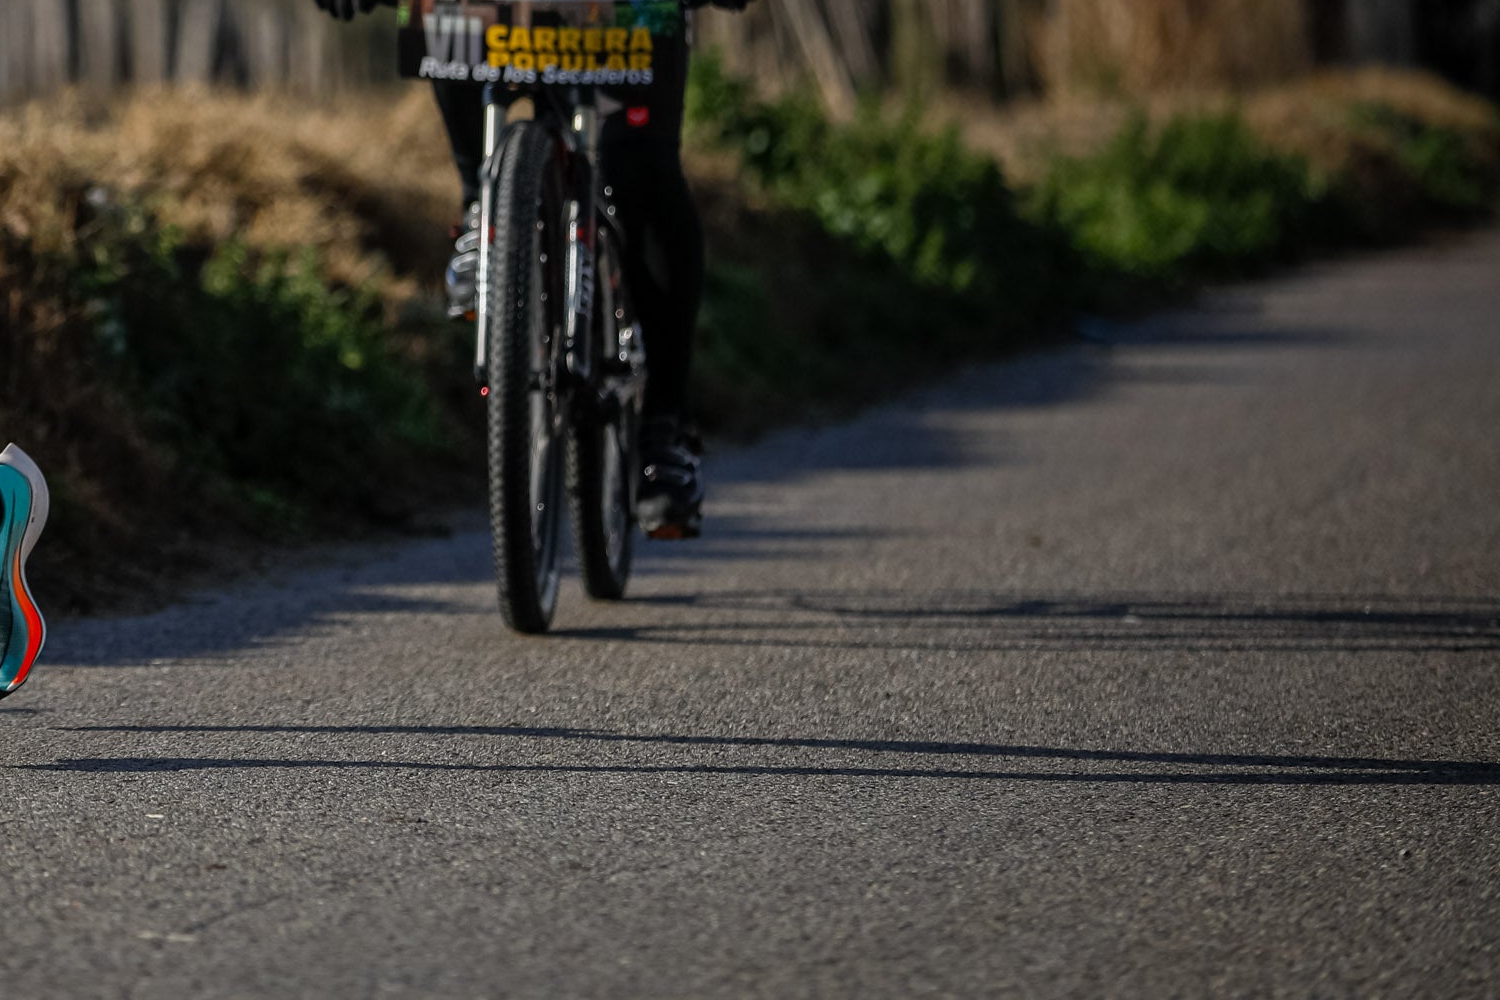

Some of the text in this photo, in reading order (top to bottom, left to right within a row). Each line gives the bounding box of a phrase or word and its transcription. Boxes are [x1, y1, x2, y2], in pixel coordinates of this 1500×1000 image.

[423, 14, 483, 64] VII
[486, 24, 653, 50] CARRERA
[418, 56, 653, 85] Ruta de los Secaderos
[487, 51, 653, 72] POPULAR
